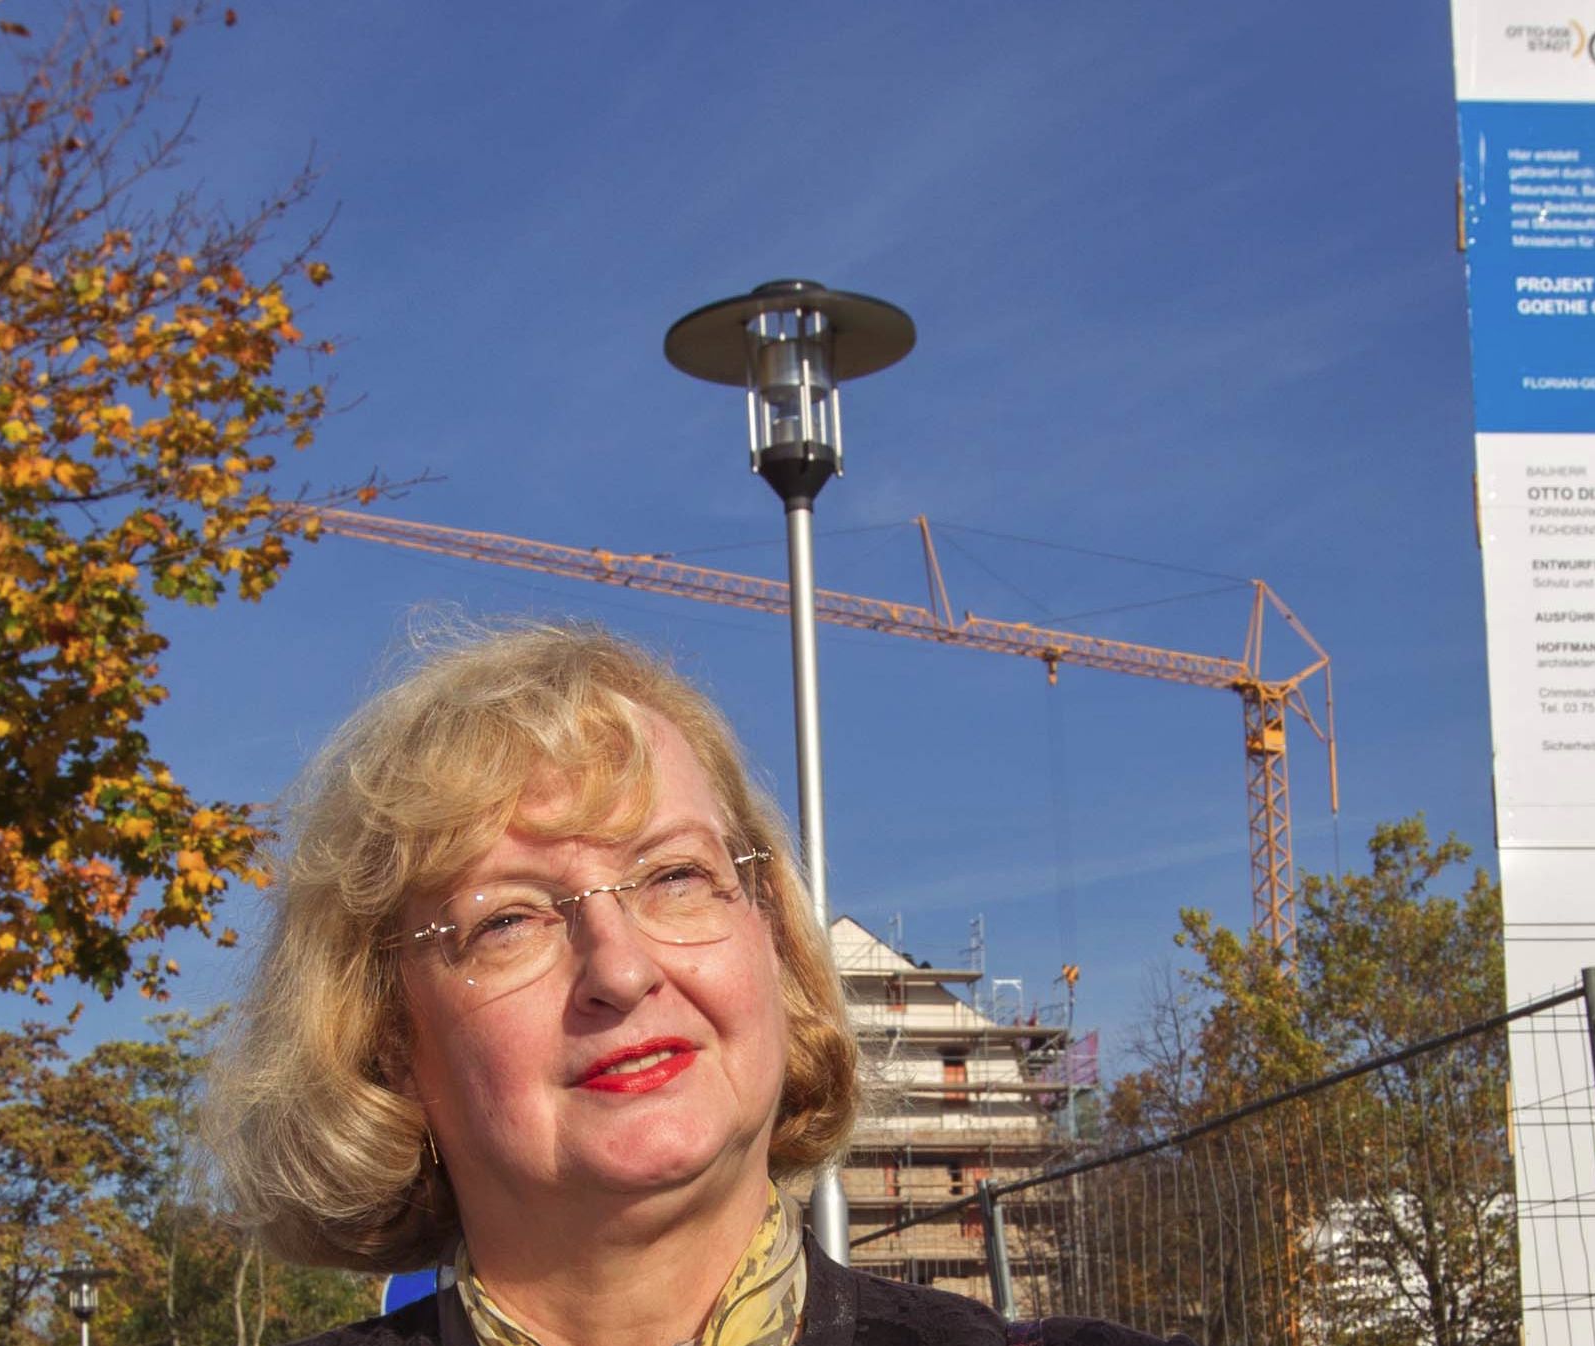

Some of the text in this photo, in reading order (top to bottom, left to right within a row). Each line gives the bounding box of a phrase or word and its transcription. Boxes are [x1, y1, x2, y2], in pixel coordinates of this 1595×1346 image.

[1516, 277, 1594, 293] PROJEKT
[1517, 299, 1588, 315] GOETHE
[1526, 466, 1587, 477] BAUHERR
[1527, 488, 1573, 500] OTTO
[1533, 577, 1569, 588] Schulz
[1573, 578, 1593, 588] und
